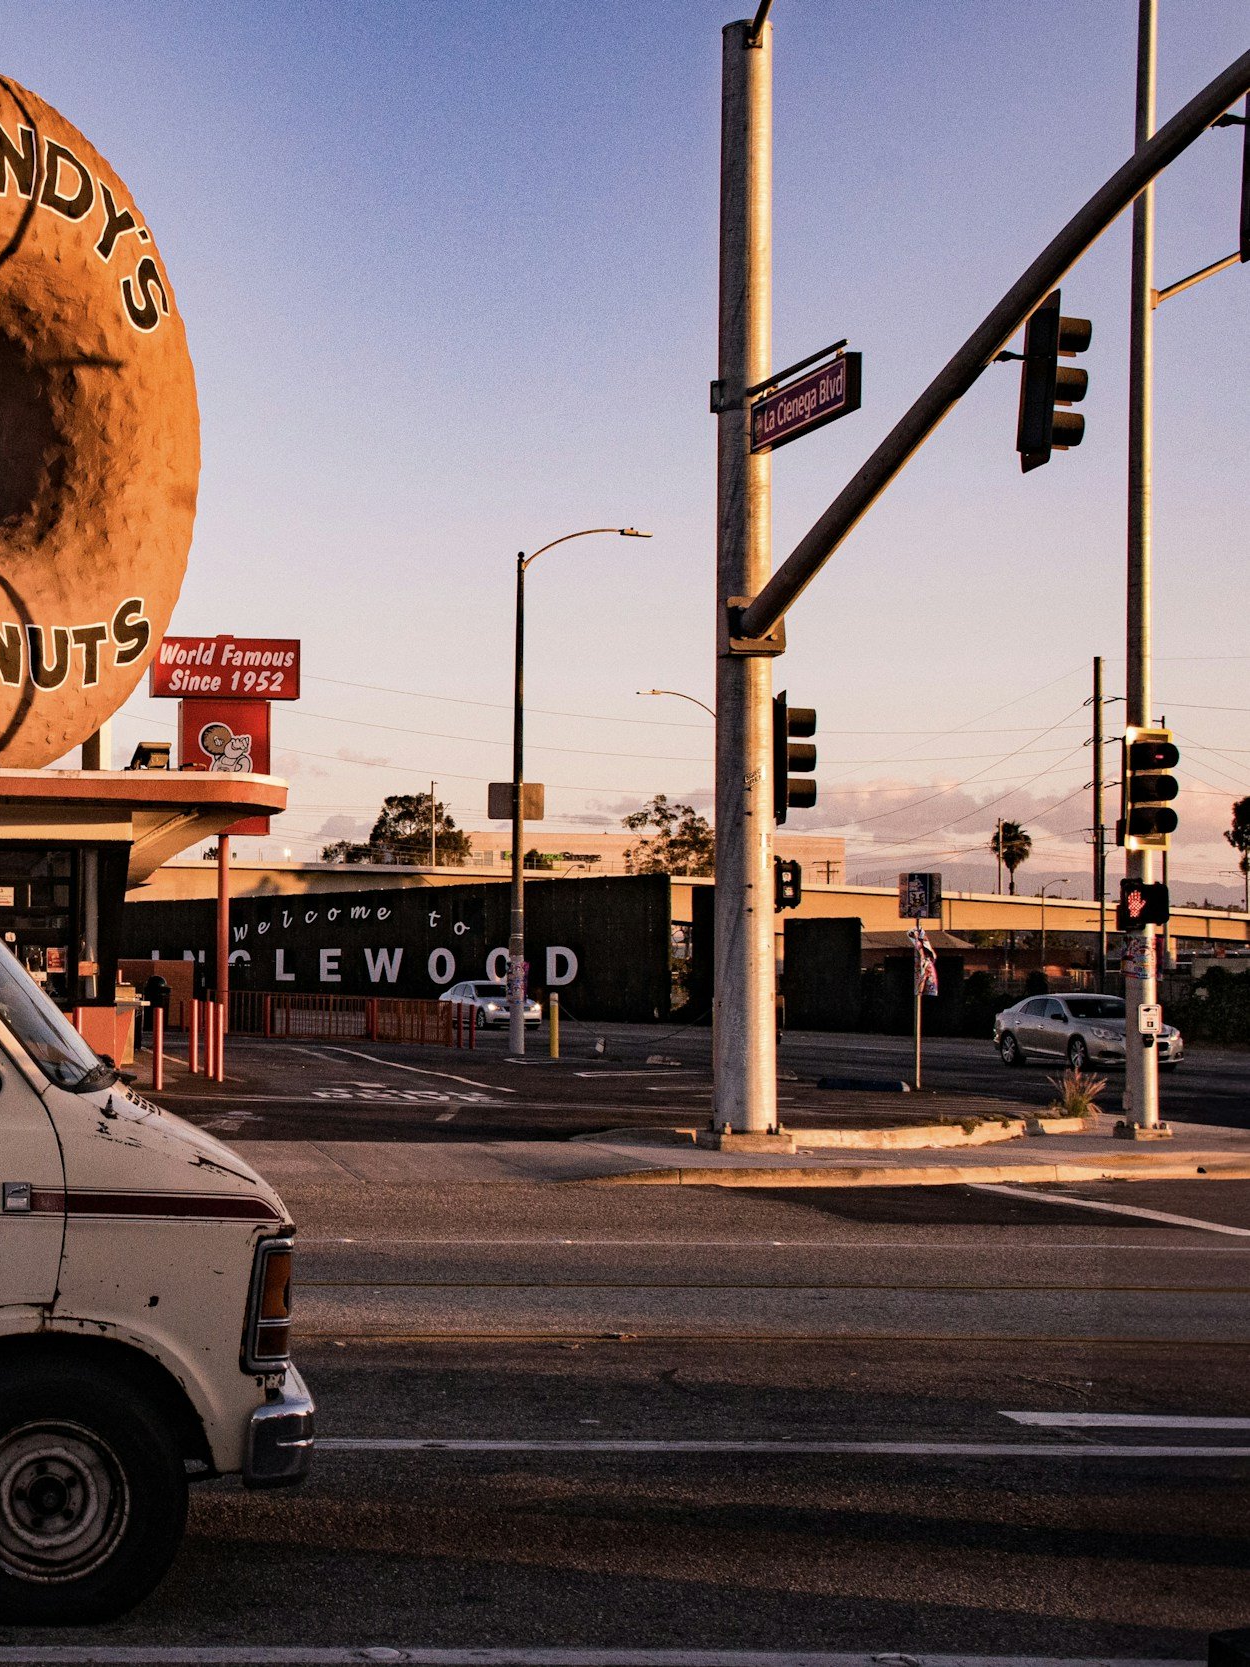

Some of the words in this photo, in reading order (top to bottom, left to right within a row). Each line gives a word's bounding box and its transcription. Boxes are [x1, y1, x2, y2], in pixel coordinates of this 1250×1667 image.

[764, 410, 775, 432] La
[777, 387, 818, 426] Cienega
[819, 367, 844, 405] Blvd
[160, 643, 217, 667] World
[221, 644, 295, 668] Famous
[168, 669, 222, 692] Since
[230, 671, 285, 692] 1952
[233, 905, 392, 943] welcome
[428, 910, 471, 935] to
